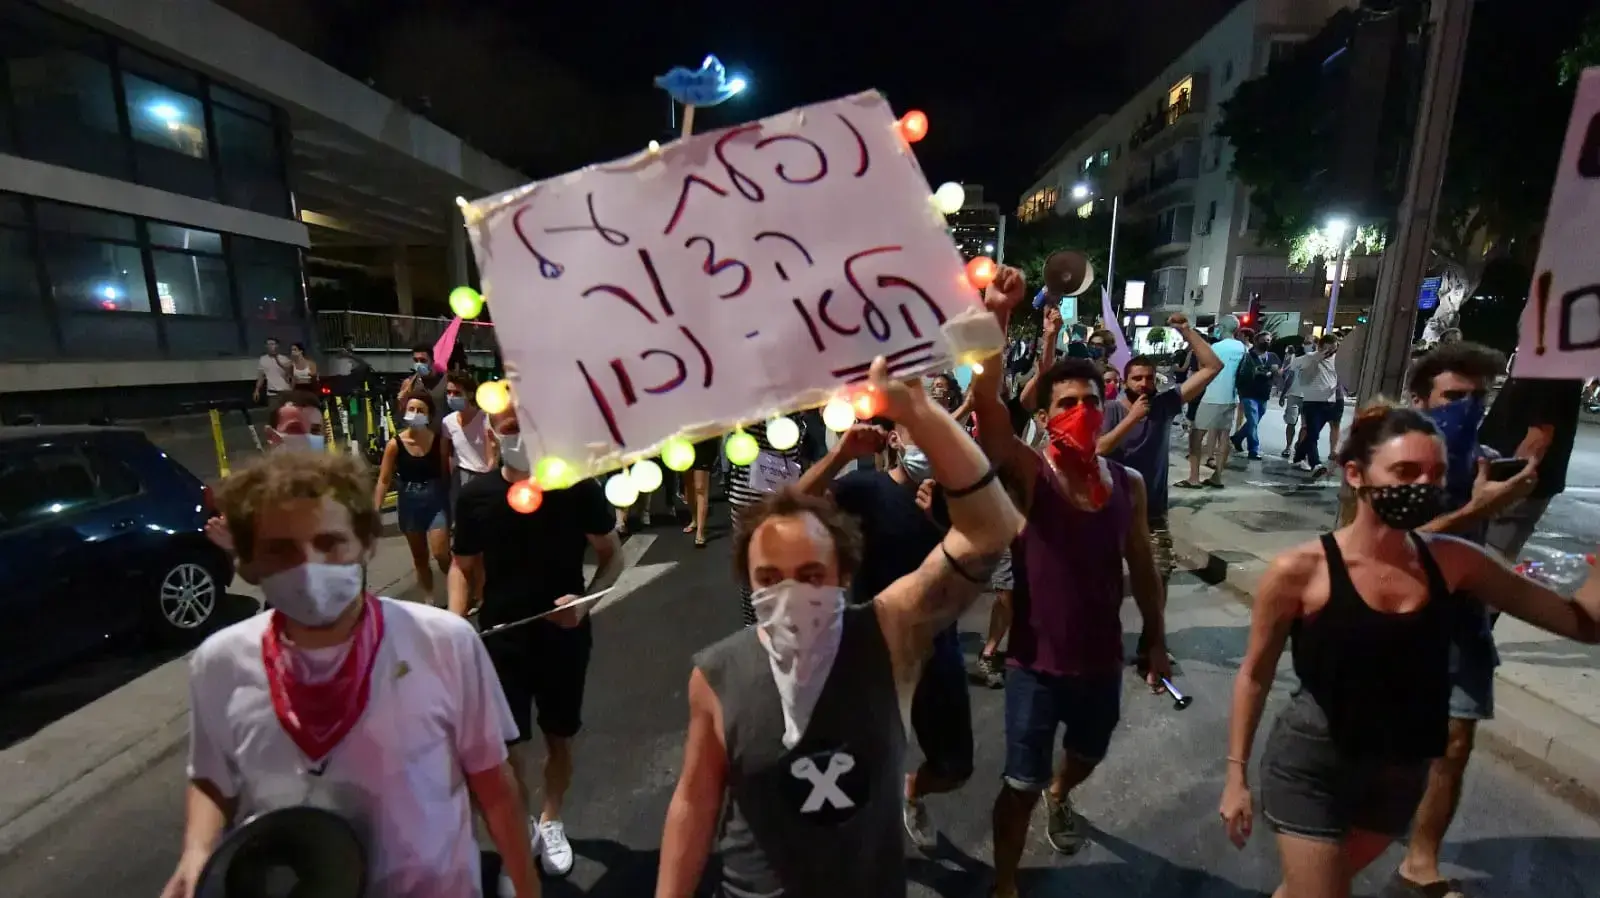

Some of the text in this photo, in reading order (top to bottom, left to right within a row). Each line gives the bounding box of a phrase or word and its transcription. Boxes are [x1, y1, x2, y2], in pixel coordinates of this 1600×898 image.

[513, 114, 869, 280] נפלת על
[575, 324, 714, 448] נכון
